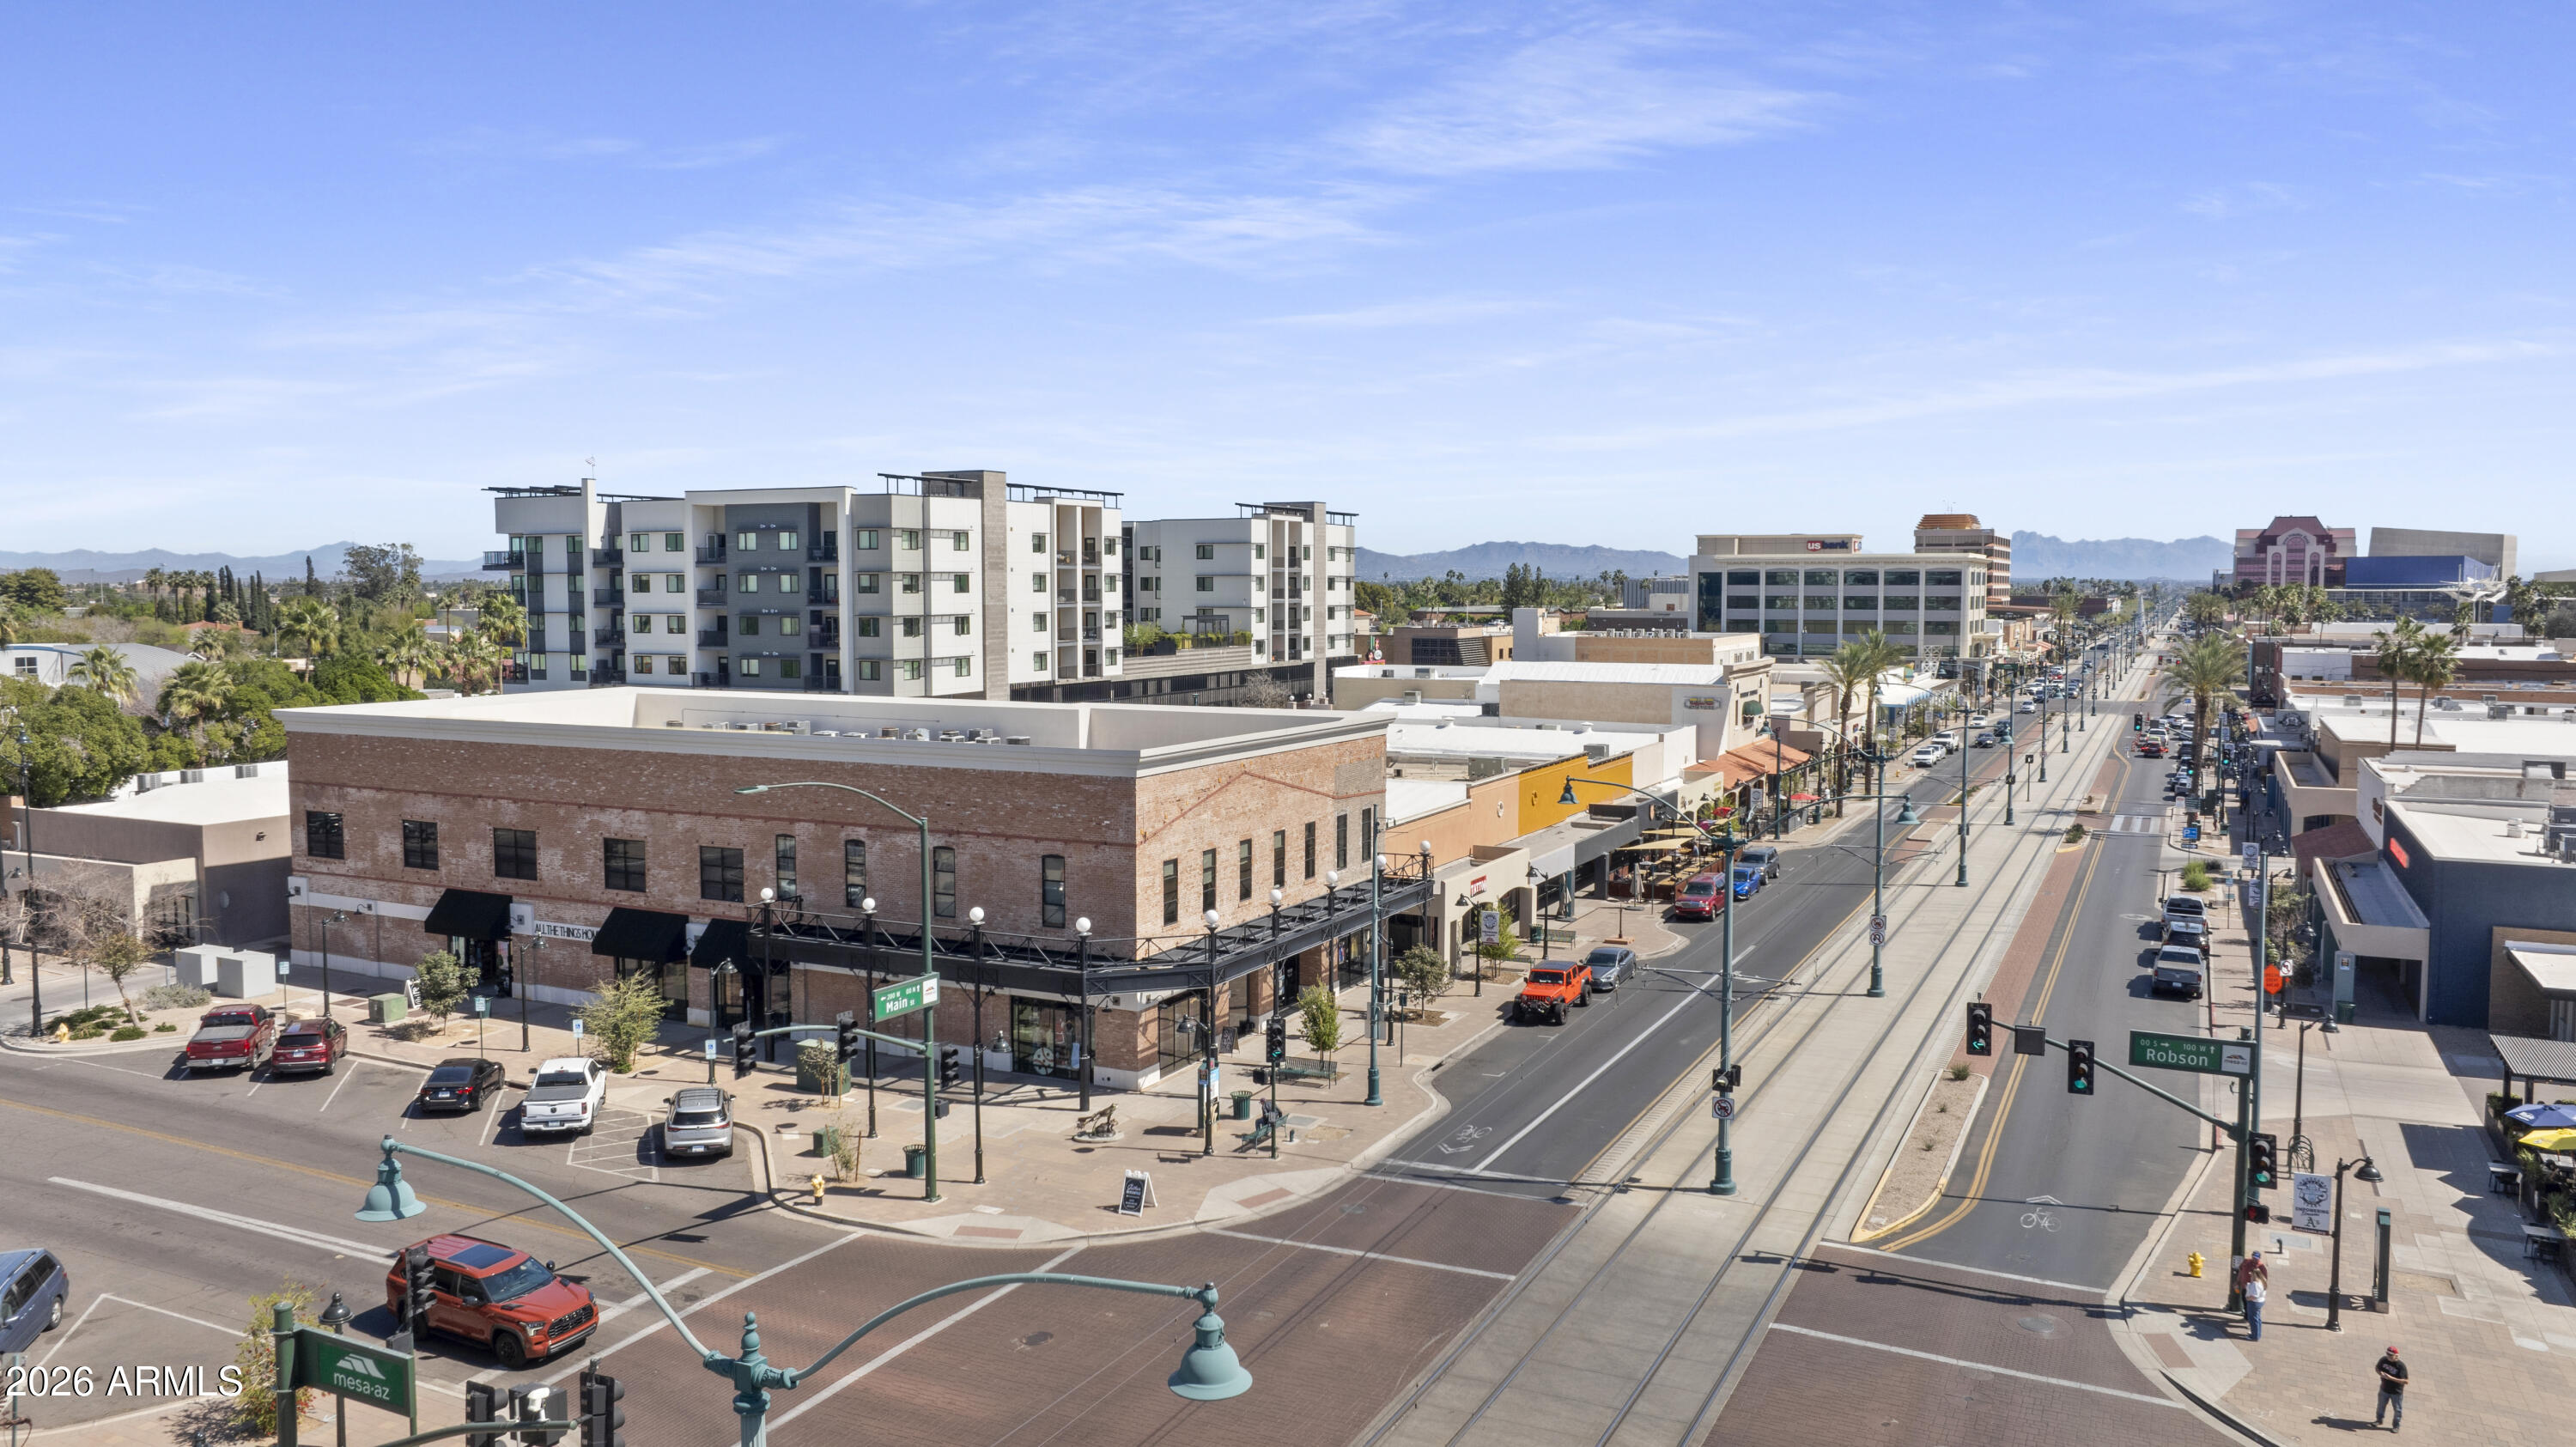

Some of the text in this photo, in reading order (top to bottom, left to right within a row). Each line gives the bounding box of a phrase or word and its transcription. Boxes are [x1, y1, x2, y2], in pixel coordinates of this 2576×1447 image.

[546, 925, 560, 936] THE
[559, 926, 581, 939] THINGS
[581, 929, 600, 940] HOM
[886, 997, 908, 1013] Main
[2147, 1048, 2208, 1067] Robson
